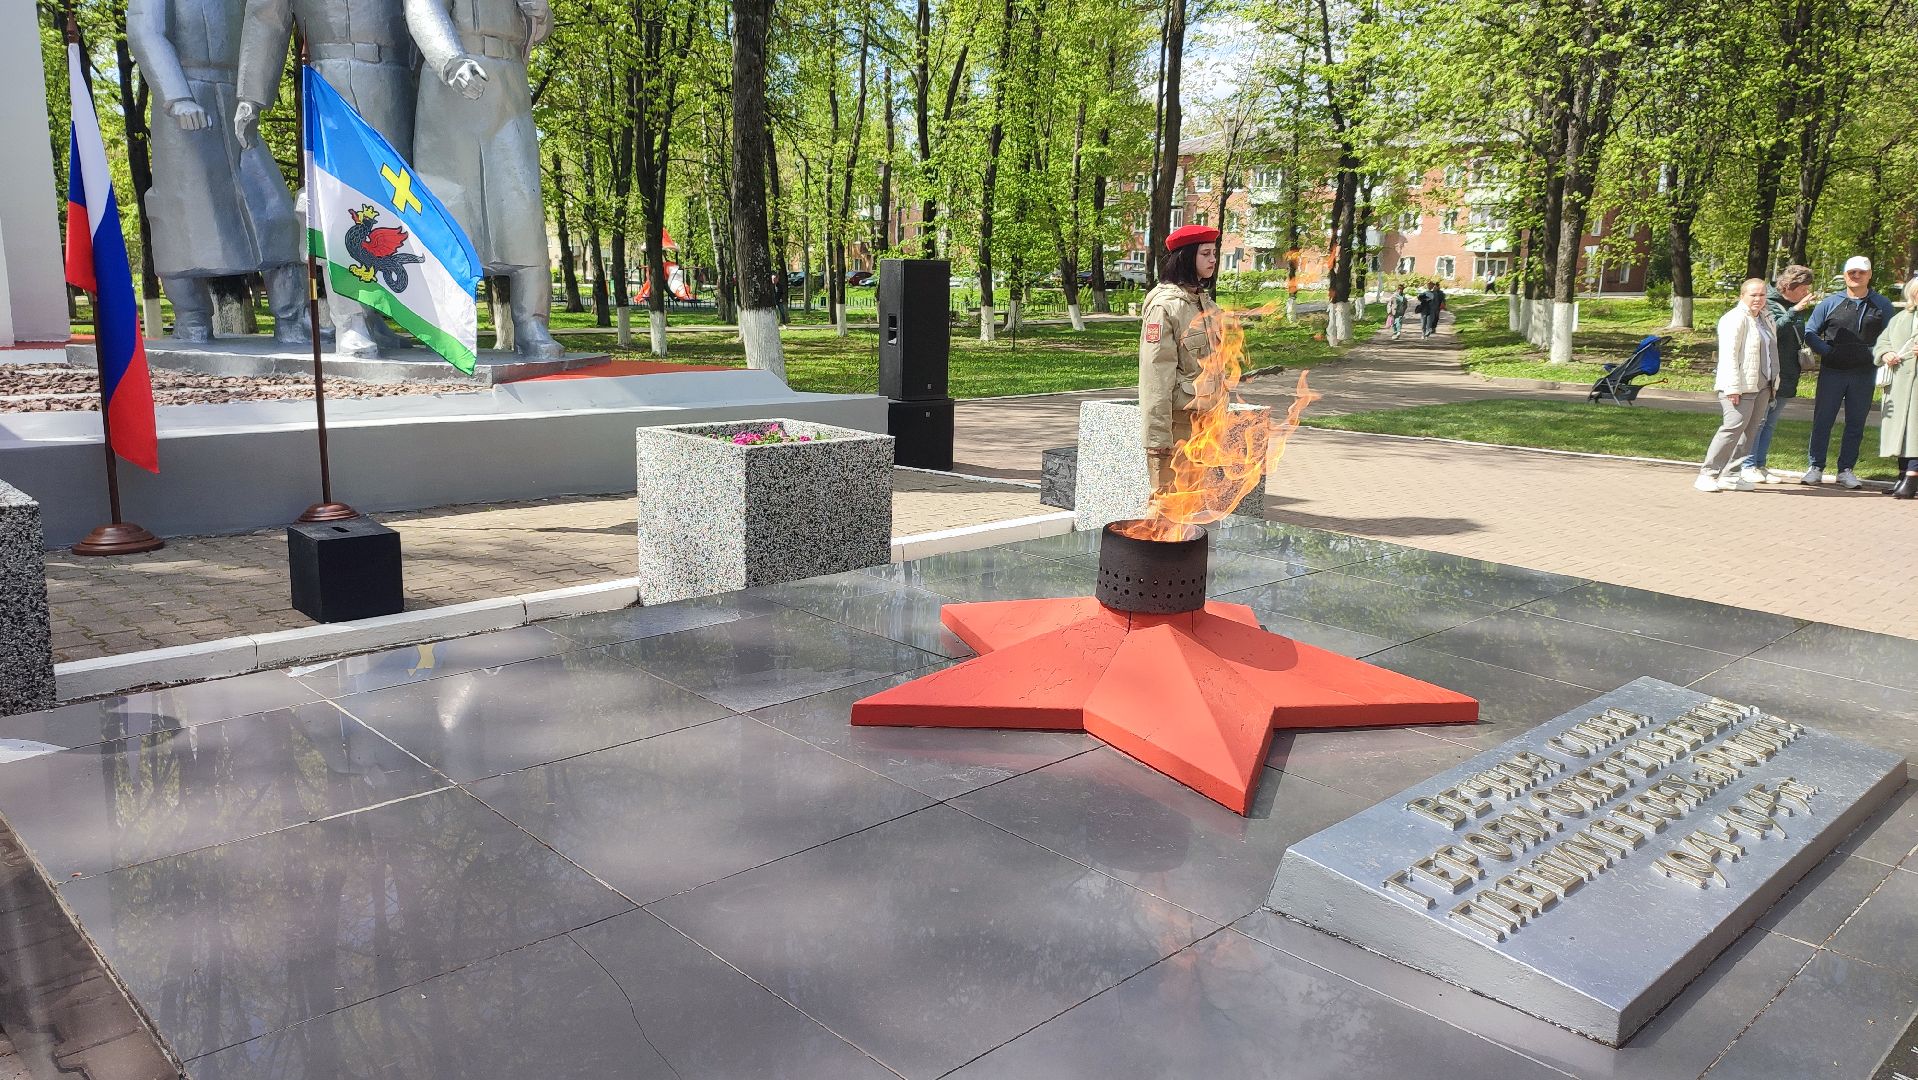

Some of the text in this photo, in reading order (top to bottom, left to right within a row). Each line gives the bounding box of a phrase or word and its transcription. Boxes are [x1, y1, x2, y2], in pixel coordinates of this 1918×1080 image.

[1404, 706, 1655, 832] ВЕЧНАЯ СЛАВА
[1608, 771, 1718, 836] БОЯХ
[1588, 818, 1647, 852] В
[1447, 830, 1627, 944] ПАВШИМ
